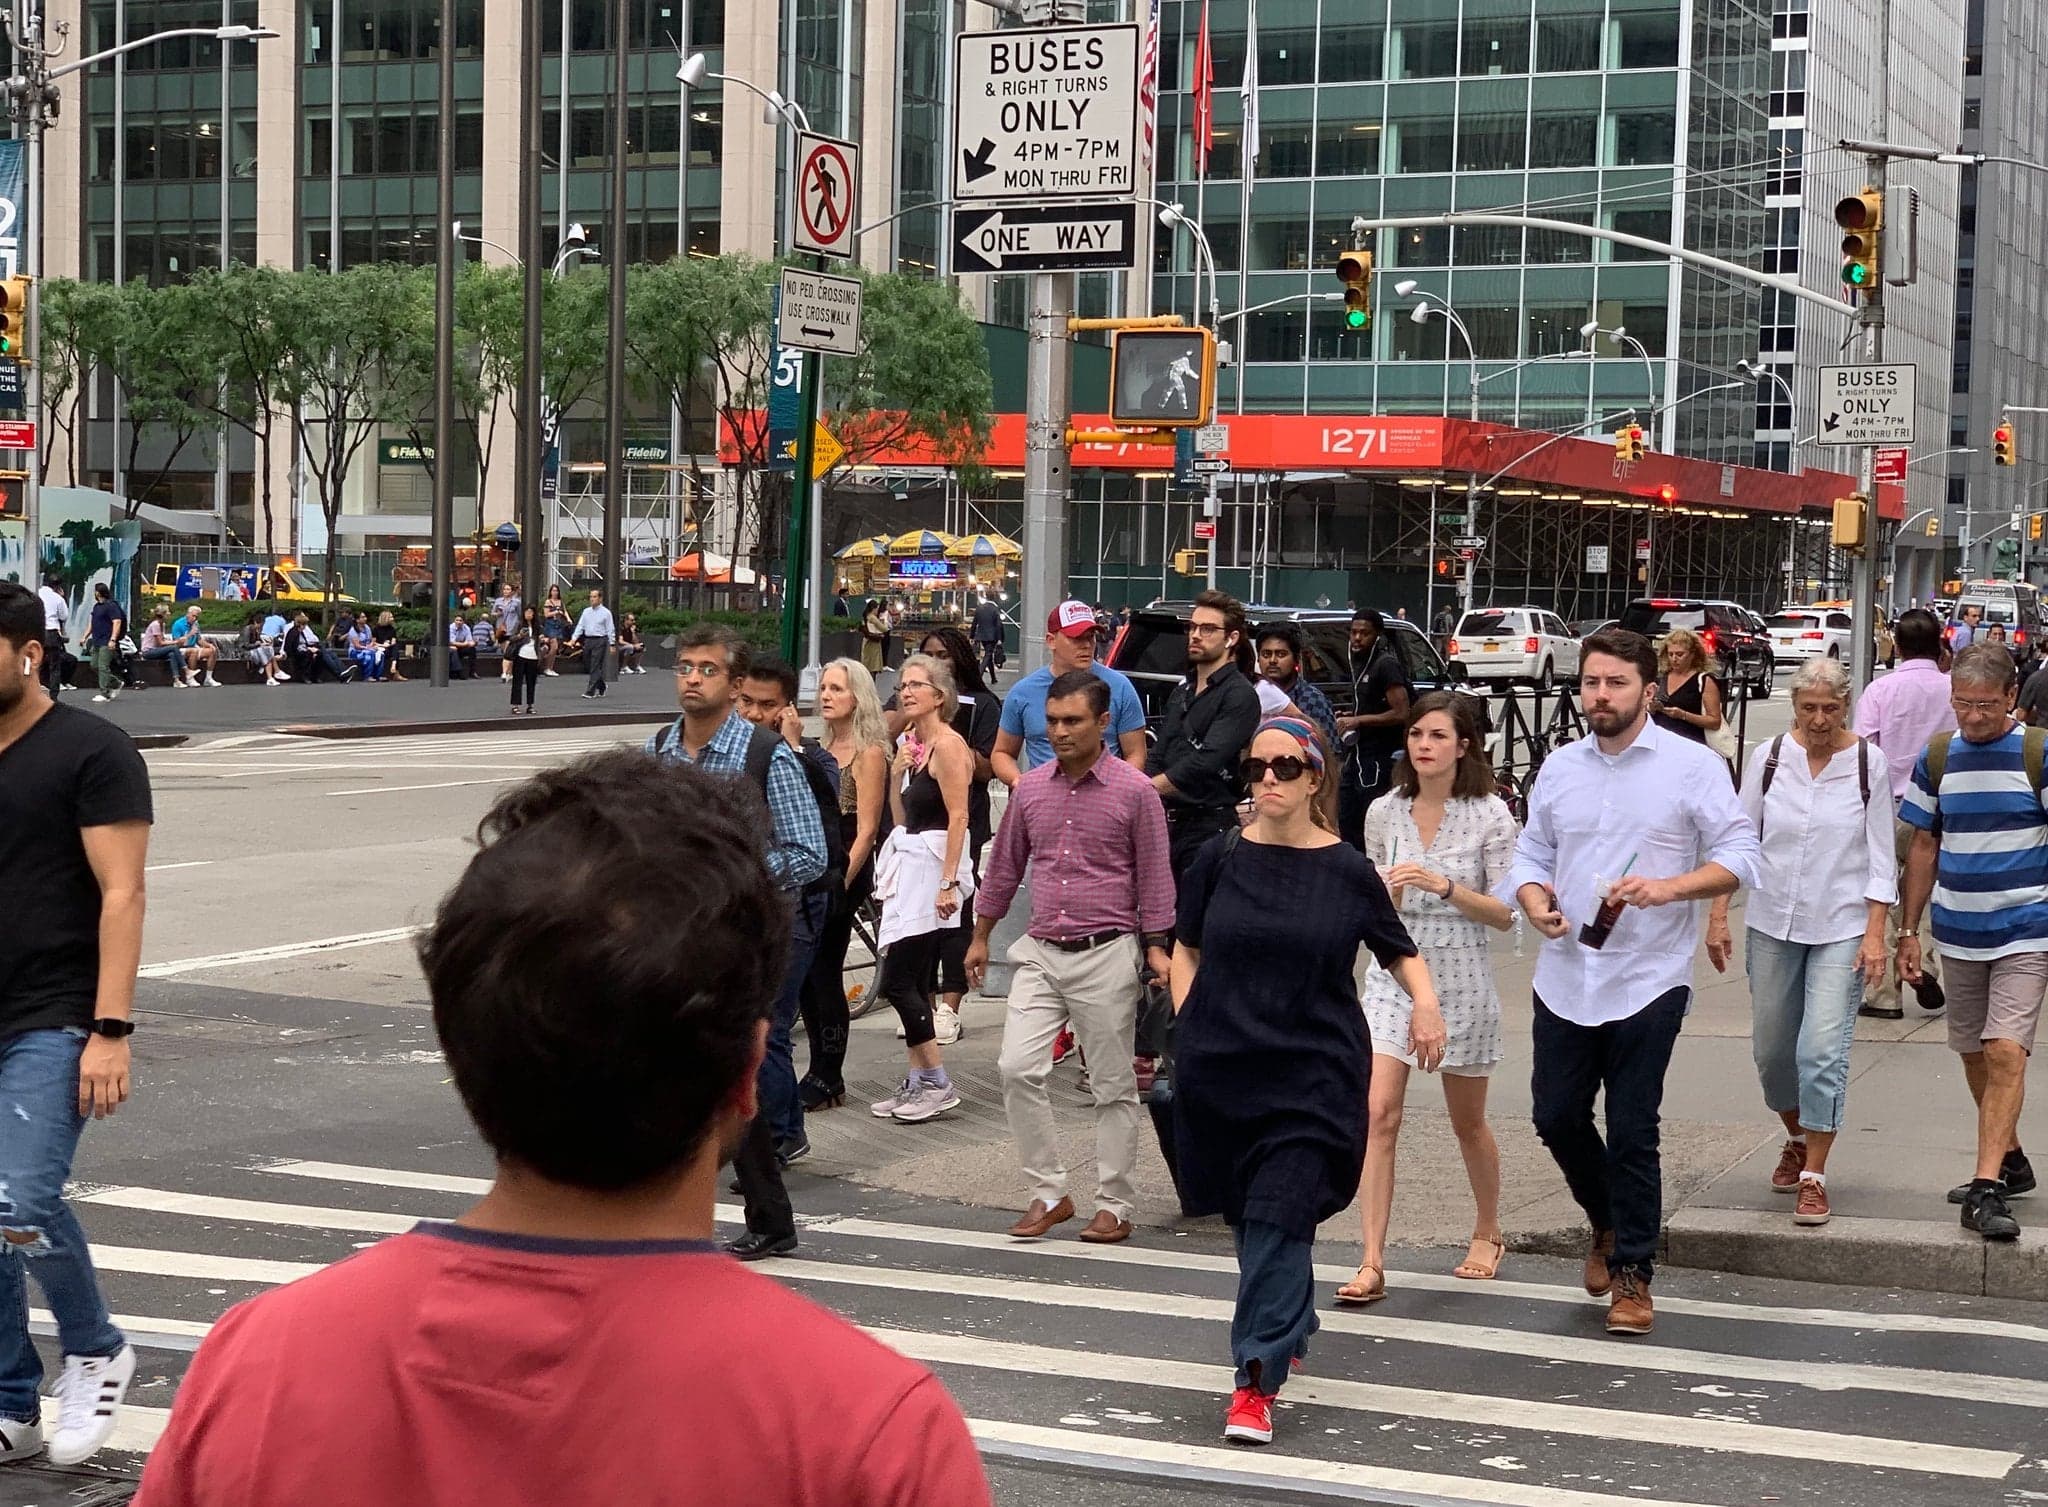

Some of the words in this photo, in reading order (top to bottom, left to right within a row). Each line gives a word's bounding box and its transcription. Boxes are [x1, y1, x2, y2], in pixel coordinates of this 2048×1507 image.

[990, 37, 1104, 75] BUSES
[985, 82, 996, 97] &
[1002, 79, 1048, 96] RIGHT
[1055, 76, 1108, 94] TURNS
[1000, 98, 1090, 133] ONLY
[1004, 169, 1043, 188] MON
[1051, 170, 1091, 186] THRU
[1099, 166, 1127, 185] FRI
[981, 227, 1030, 252] ONE
[1057, 224, 1111, 249] WAY
[786, 280, 797, 296] NO
[818, 286, 857, 305] CROSSING
[788, 303, 803, 320] USE
[806, 305, 851, 326] CROSSWALK
[774, 352, 803, 394] 51
[1838, 370, 1897, 387] BUSES
[1843, 398, 1890, 414] ONLY
[1322, 428, 1387, 459] 1271
[1846, 429, 1866, 438] MON
[1870, 430, 1891, 438] THRU
[1894, 428, 1910, 437] FRI
[627, 447, 668, 460] Fidelity
[902, 560, 924, 573] HOT
[924, 562, 948, 574] DOG
